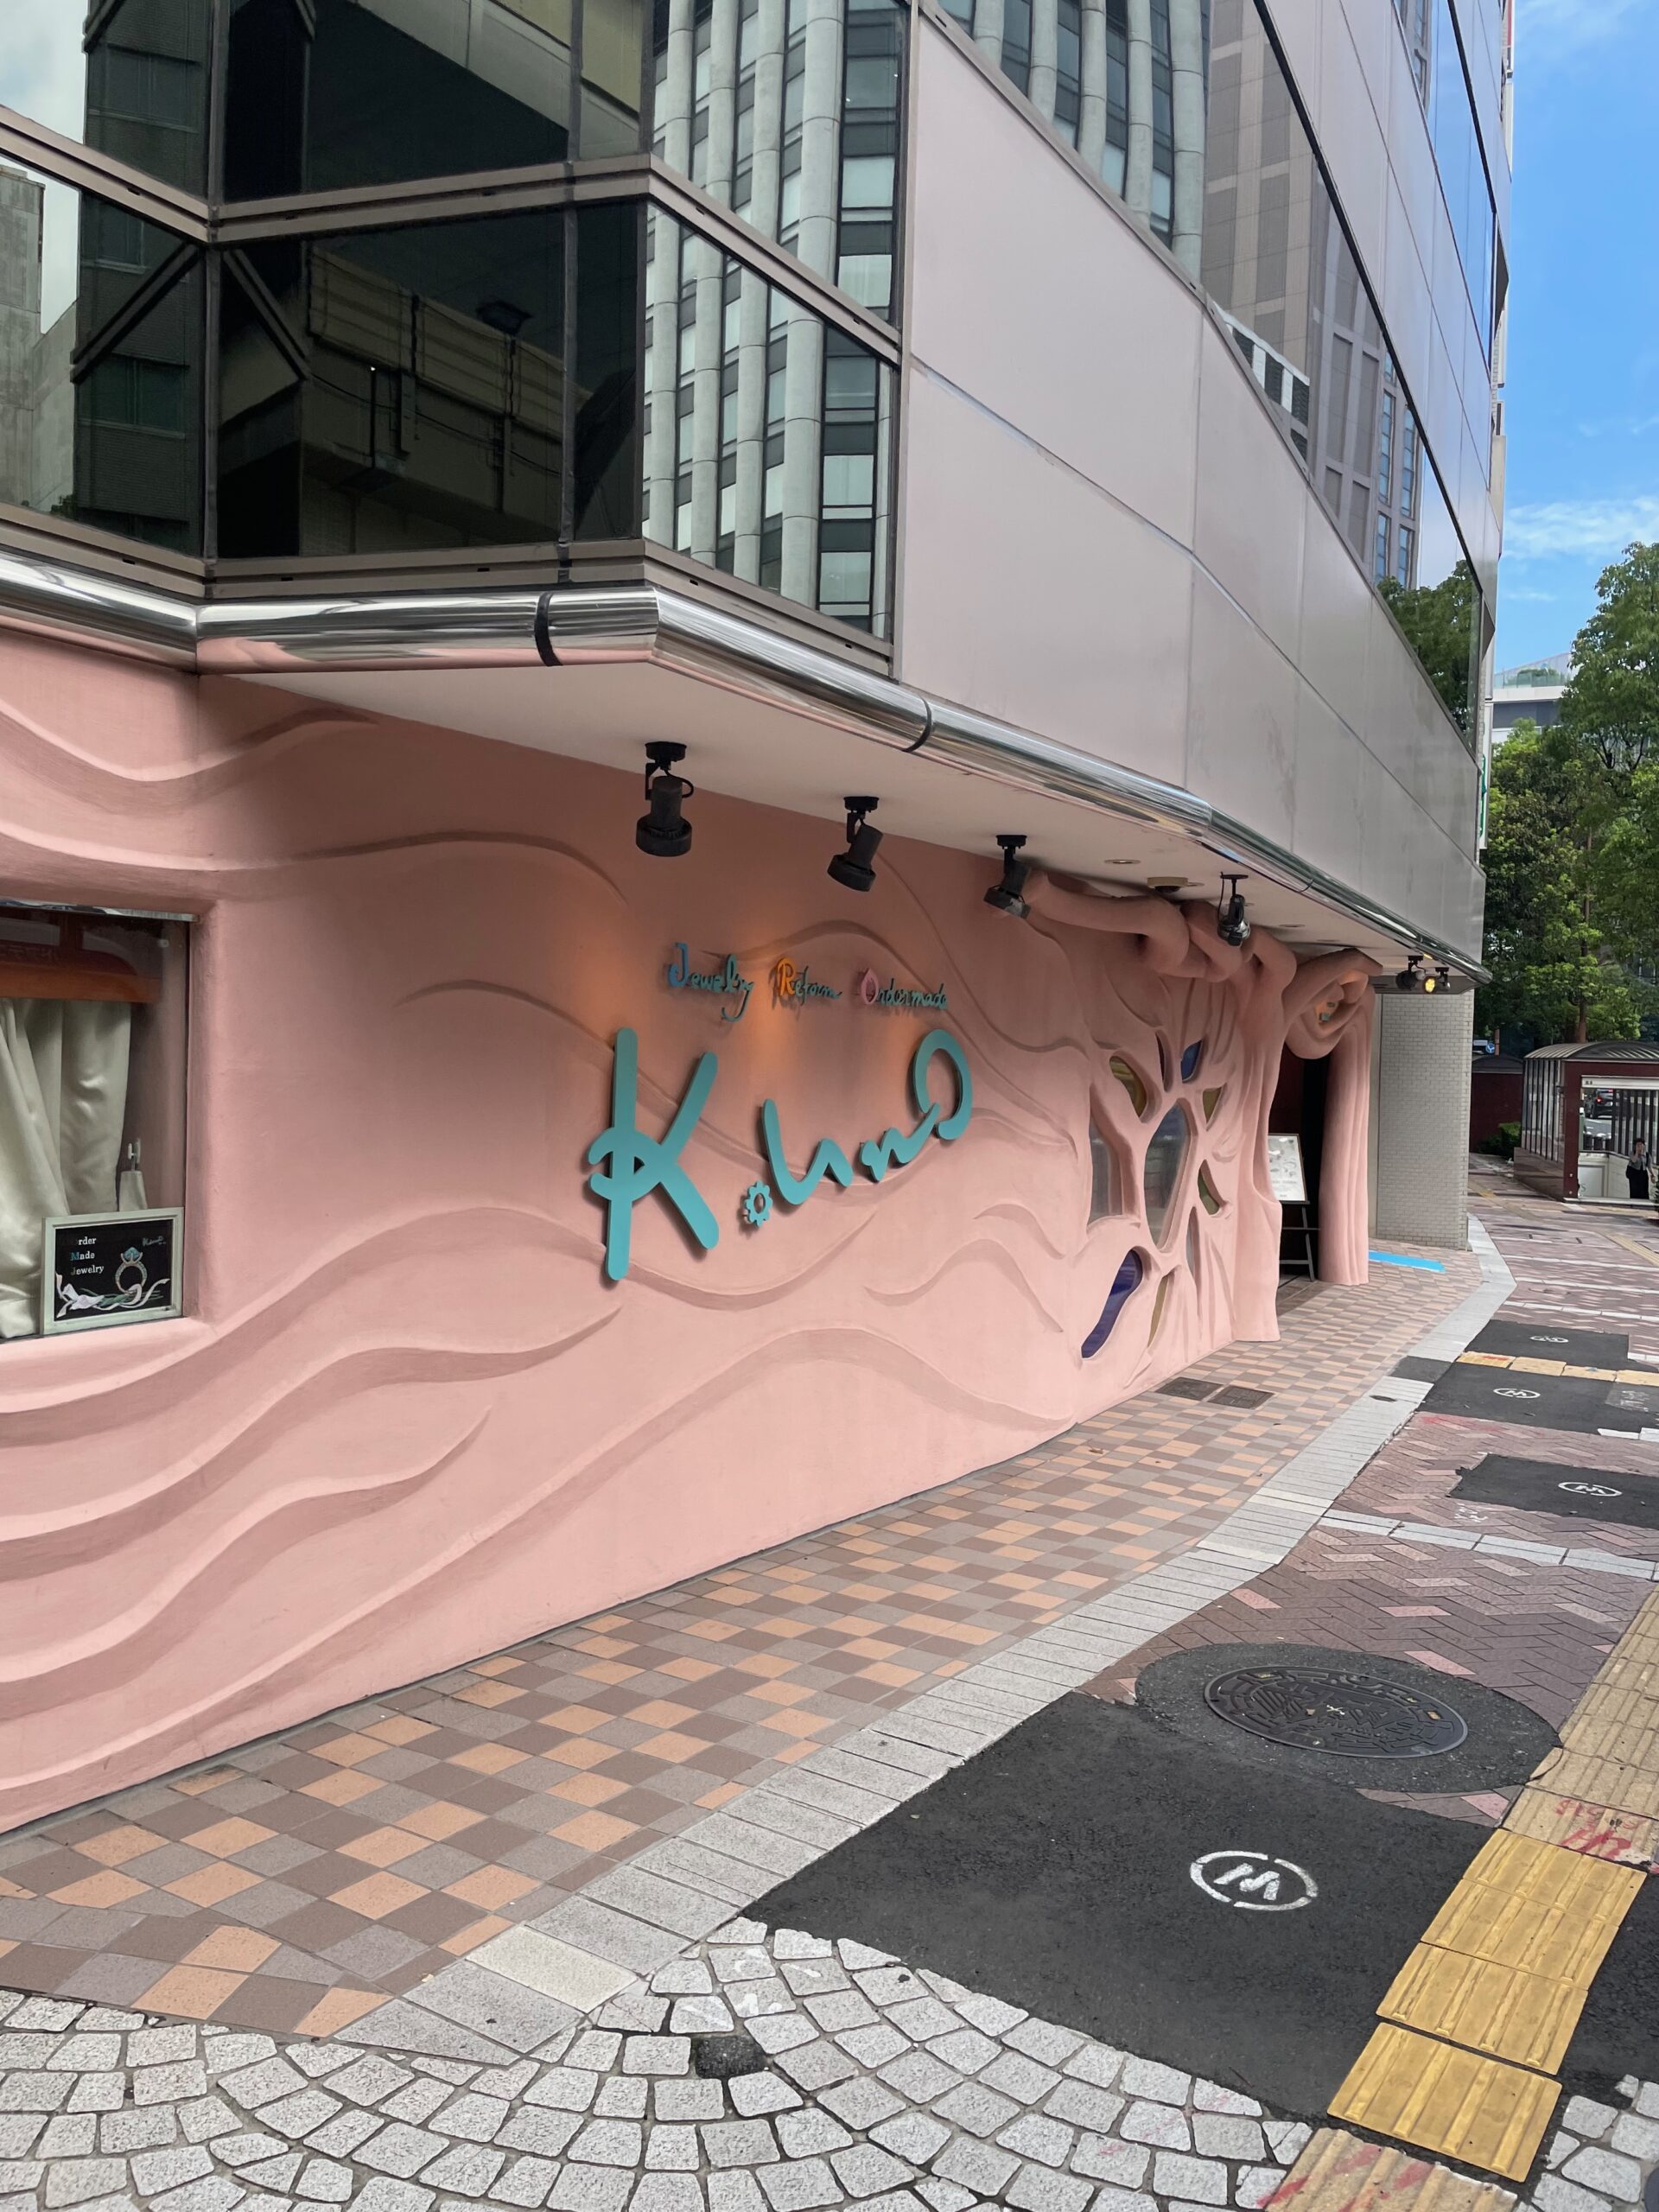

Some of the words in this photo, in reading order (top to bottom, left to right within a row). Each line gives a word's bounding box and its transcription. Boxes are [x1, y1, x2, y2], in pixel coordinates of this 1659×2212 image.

[669, 942, 753, 1022] Jewelry
[778, 957, 842, 1006] Reform
[76, 1236, 97, 1245] rder
[70, 1250, 95, 1261] Made
[71, 1265, 104, 1275] Jewelry
